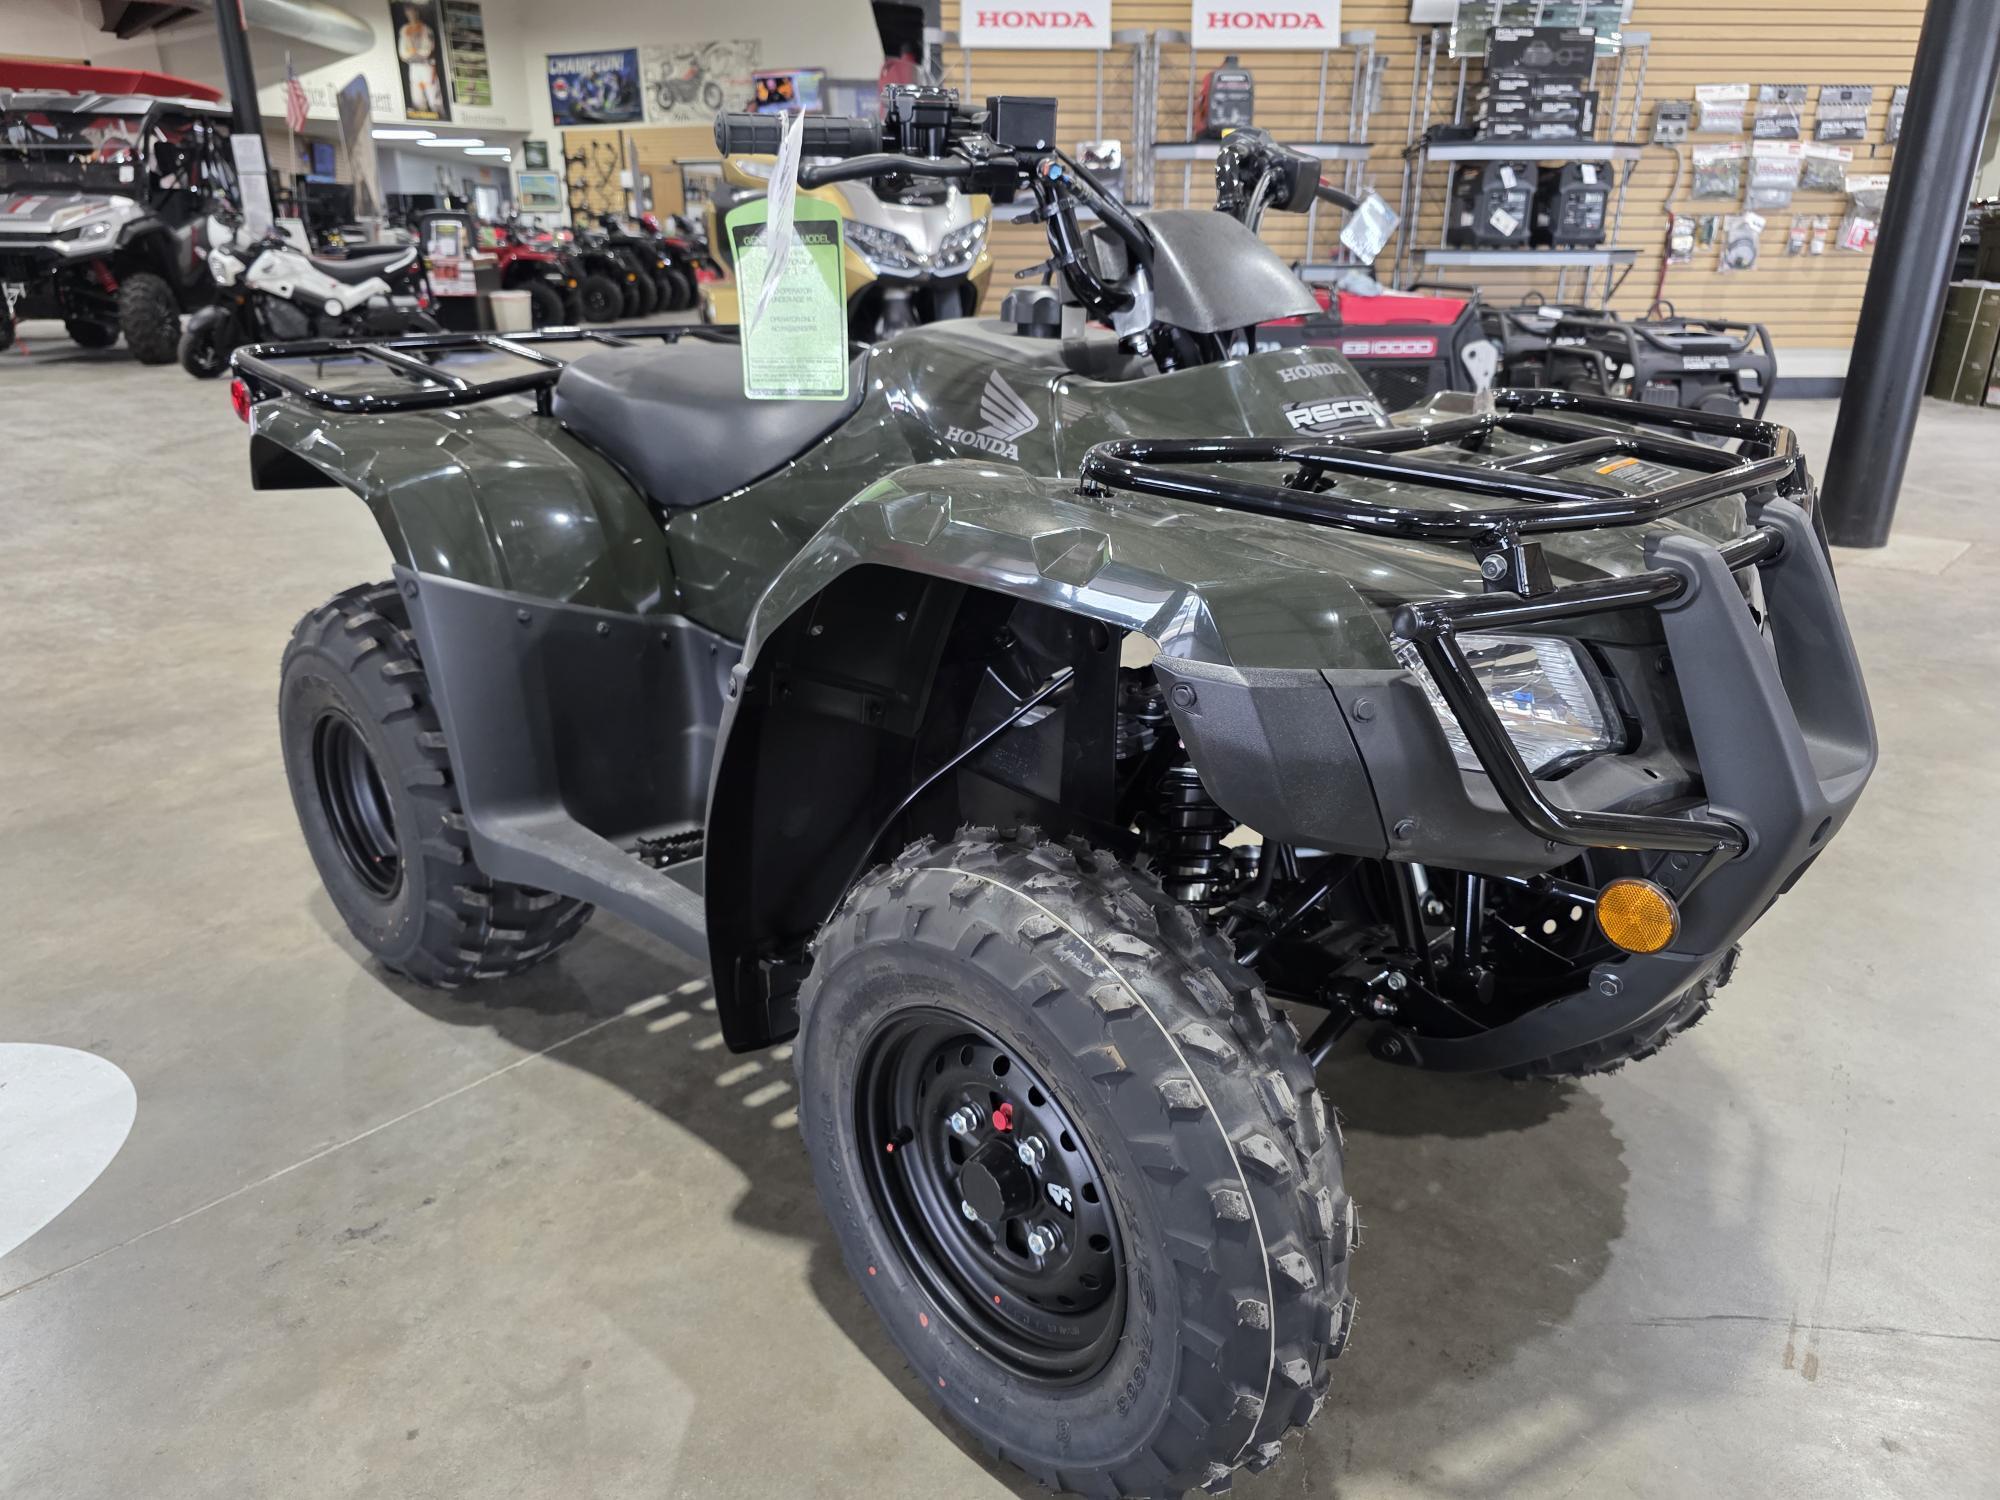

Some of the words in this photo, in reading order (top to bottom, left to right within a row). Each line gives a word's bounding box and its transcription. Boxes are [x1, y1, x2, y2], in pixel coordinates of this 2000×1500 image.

[976, 11, 1094, 28] HONDA
[1207, 12, 1324, 29] HONDA
[1276, 363, 1346, 383] HONDA
[1285, 400, 1386, 429] RECON
[944, 425, 1019, 461] HONDA
